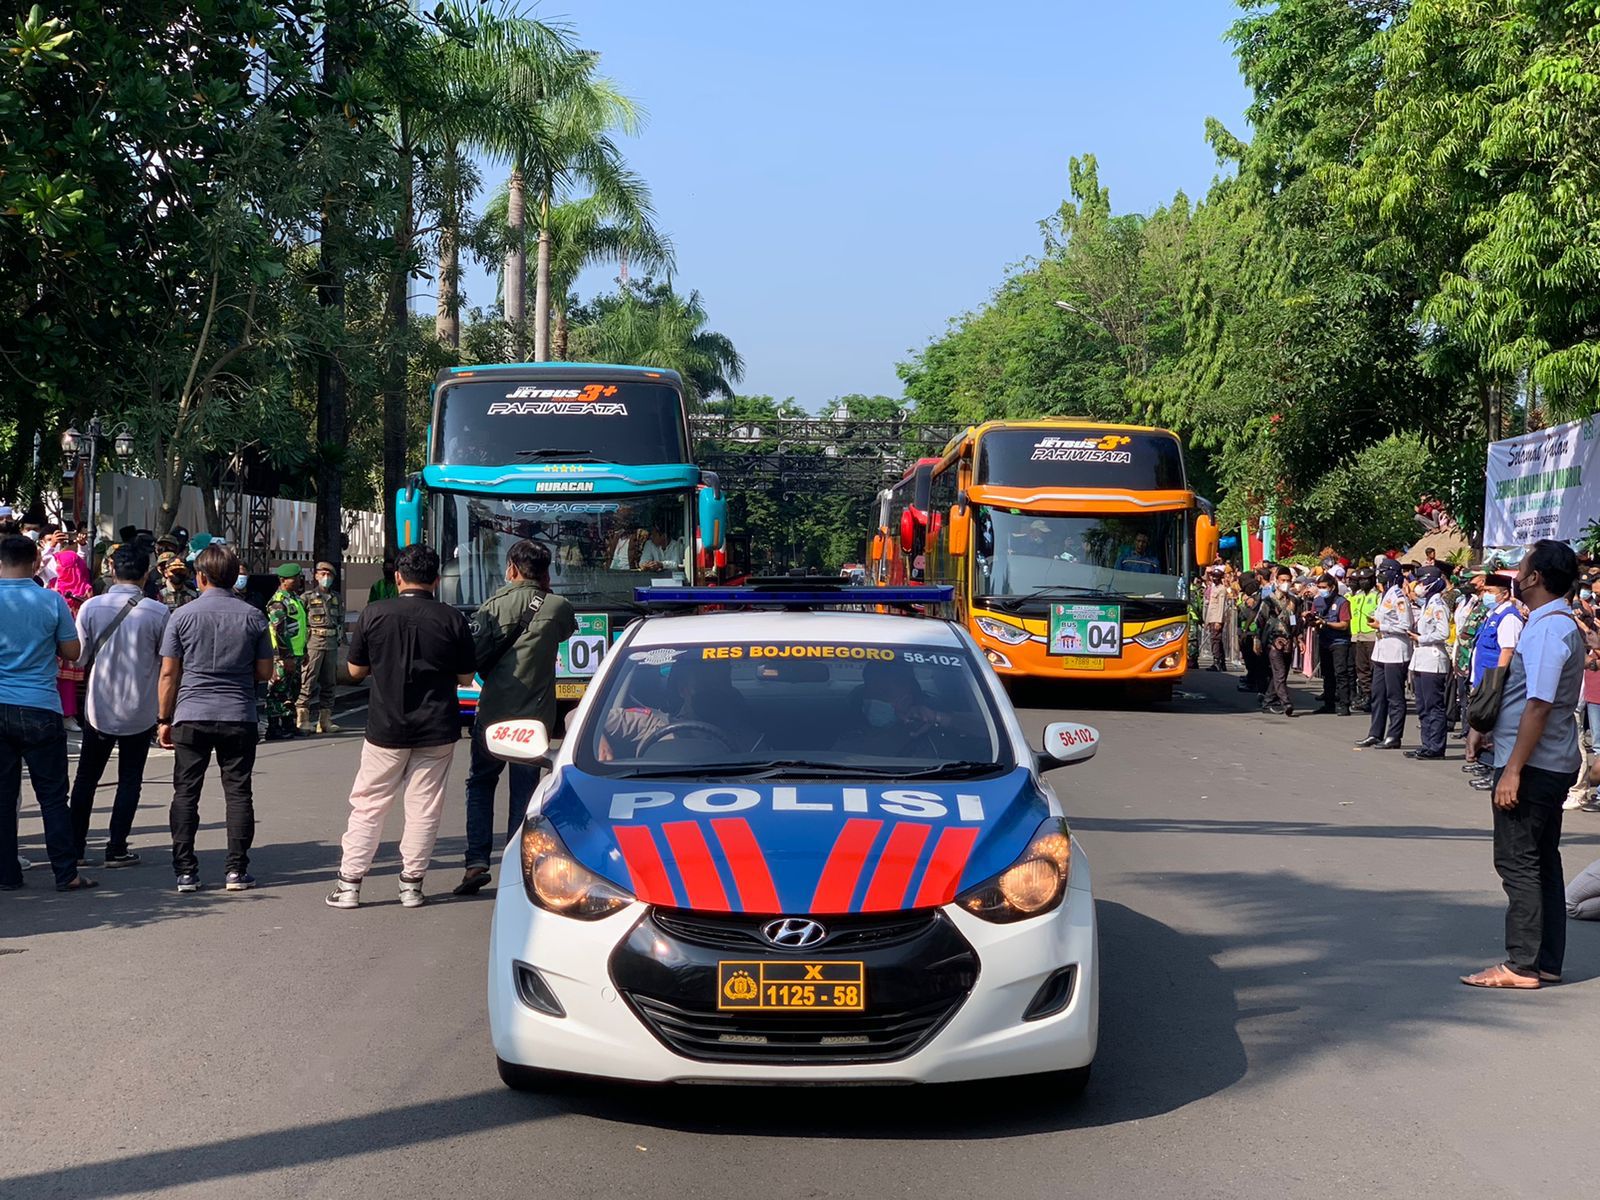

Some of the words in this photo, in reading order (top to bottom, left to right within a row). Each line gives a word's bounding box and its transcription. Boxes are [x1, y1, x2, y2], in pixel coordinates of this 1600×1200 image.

[487, 402, 628, 416] PARIWISATA
[1031, 448, 1131, 463] PARIWISATA
[536, 482, 594, 492] HURACAN
[511, 503, 620, 513] VOYAGER
[1089, 625, 1117, 648] 04
[572, 640, 605, 669] 01
[702, 647, 743, 660] RES
[749, 645, 895, 661] BOJONEGORO
[903, 652, 962, 667] 58-102
[492, 726, 535, 744] 58-102
[1059, 728, 1095, 747] 58-102
[608, 787, 985, 821] POLISI
[803, 965, 824, 980] X
[767, 985, 816, 1006] 1125
[833, 985, 858, 1006] 58
